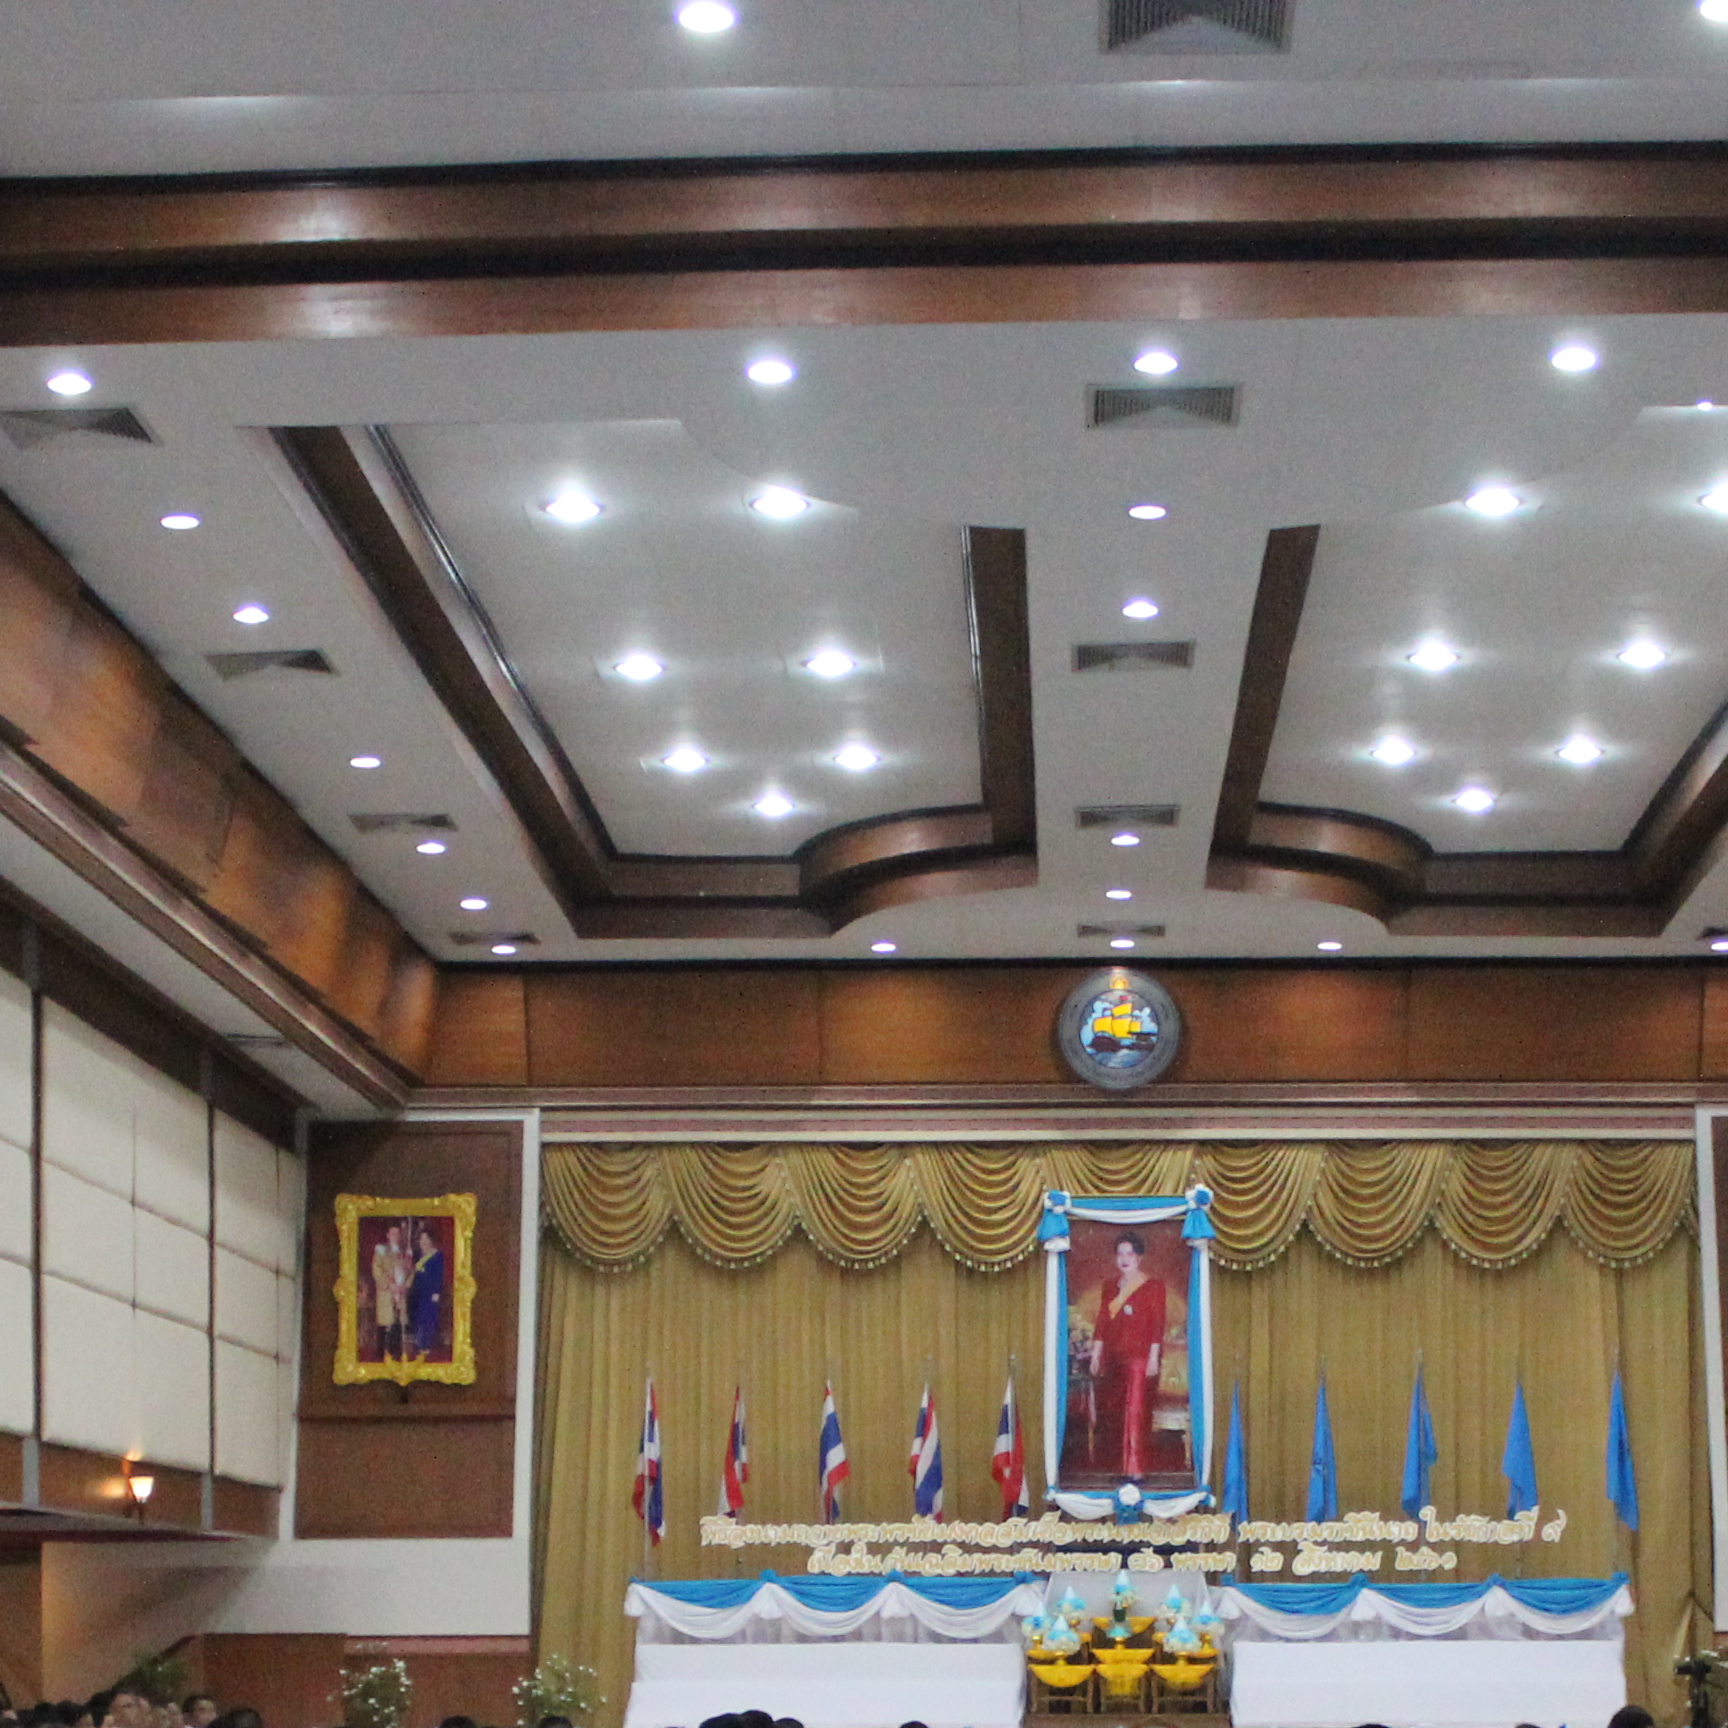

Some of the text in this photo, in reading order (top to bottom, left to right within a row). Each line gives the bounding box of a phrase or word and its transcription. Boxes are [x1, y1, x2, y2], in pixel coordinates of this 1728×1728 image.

[1237, 1511, 1419, 1543] พระบรมราชินีนาถ
[1418, 1505, 1539, 1544] ในรัชกาลที่
[1170, 1551, 1237, 1573] พรรษา
[1292, 1541, 1382, 1576] สิงหาคม
